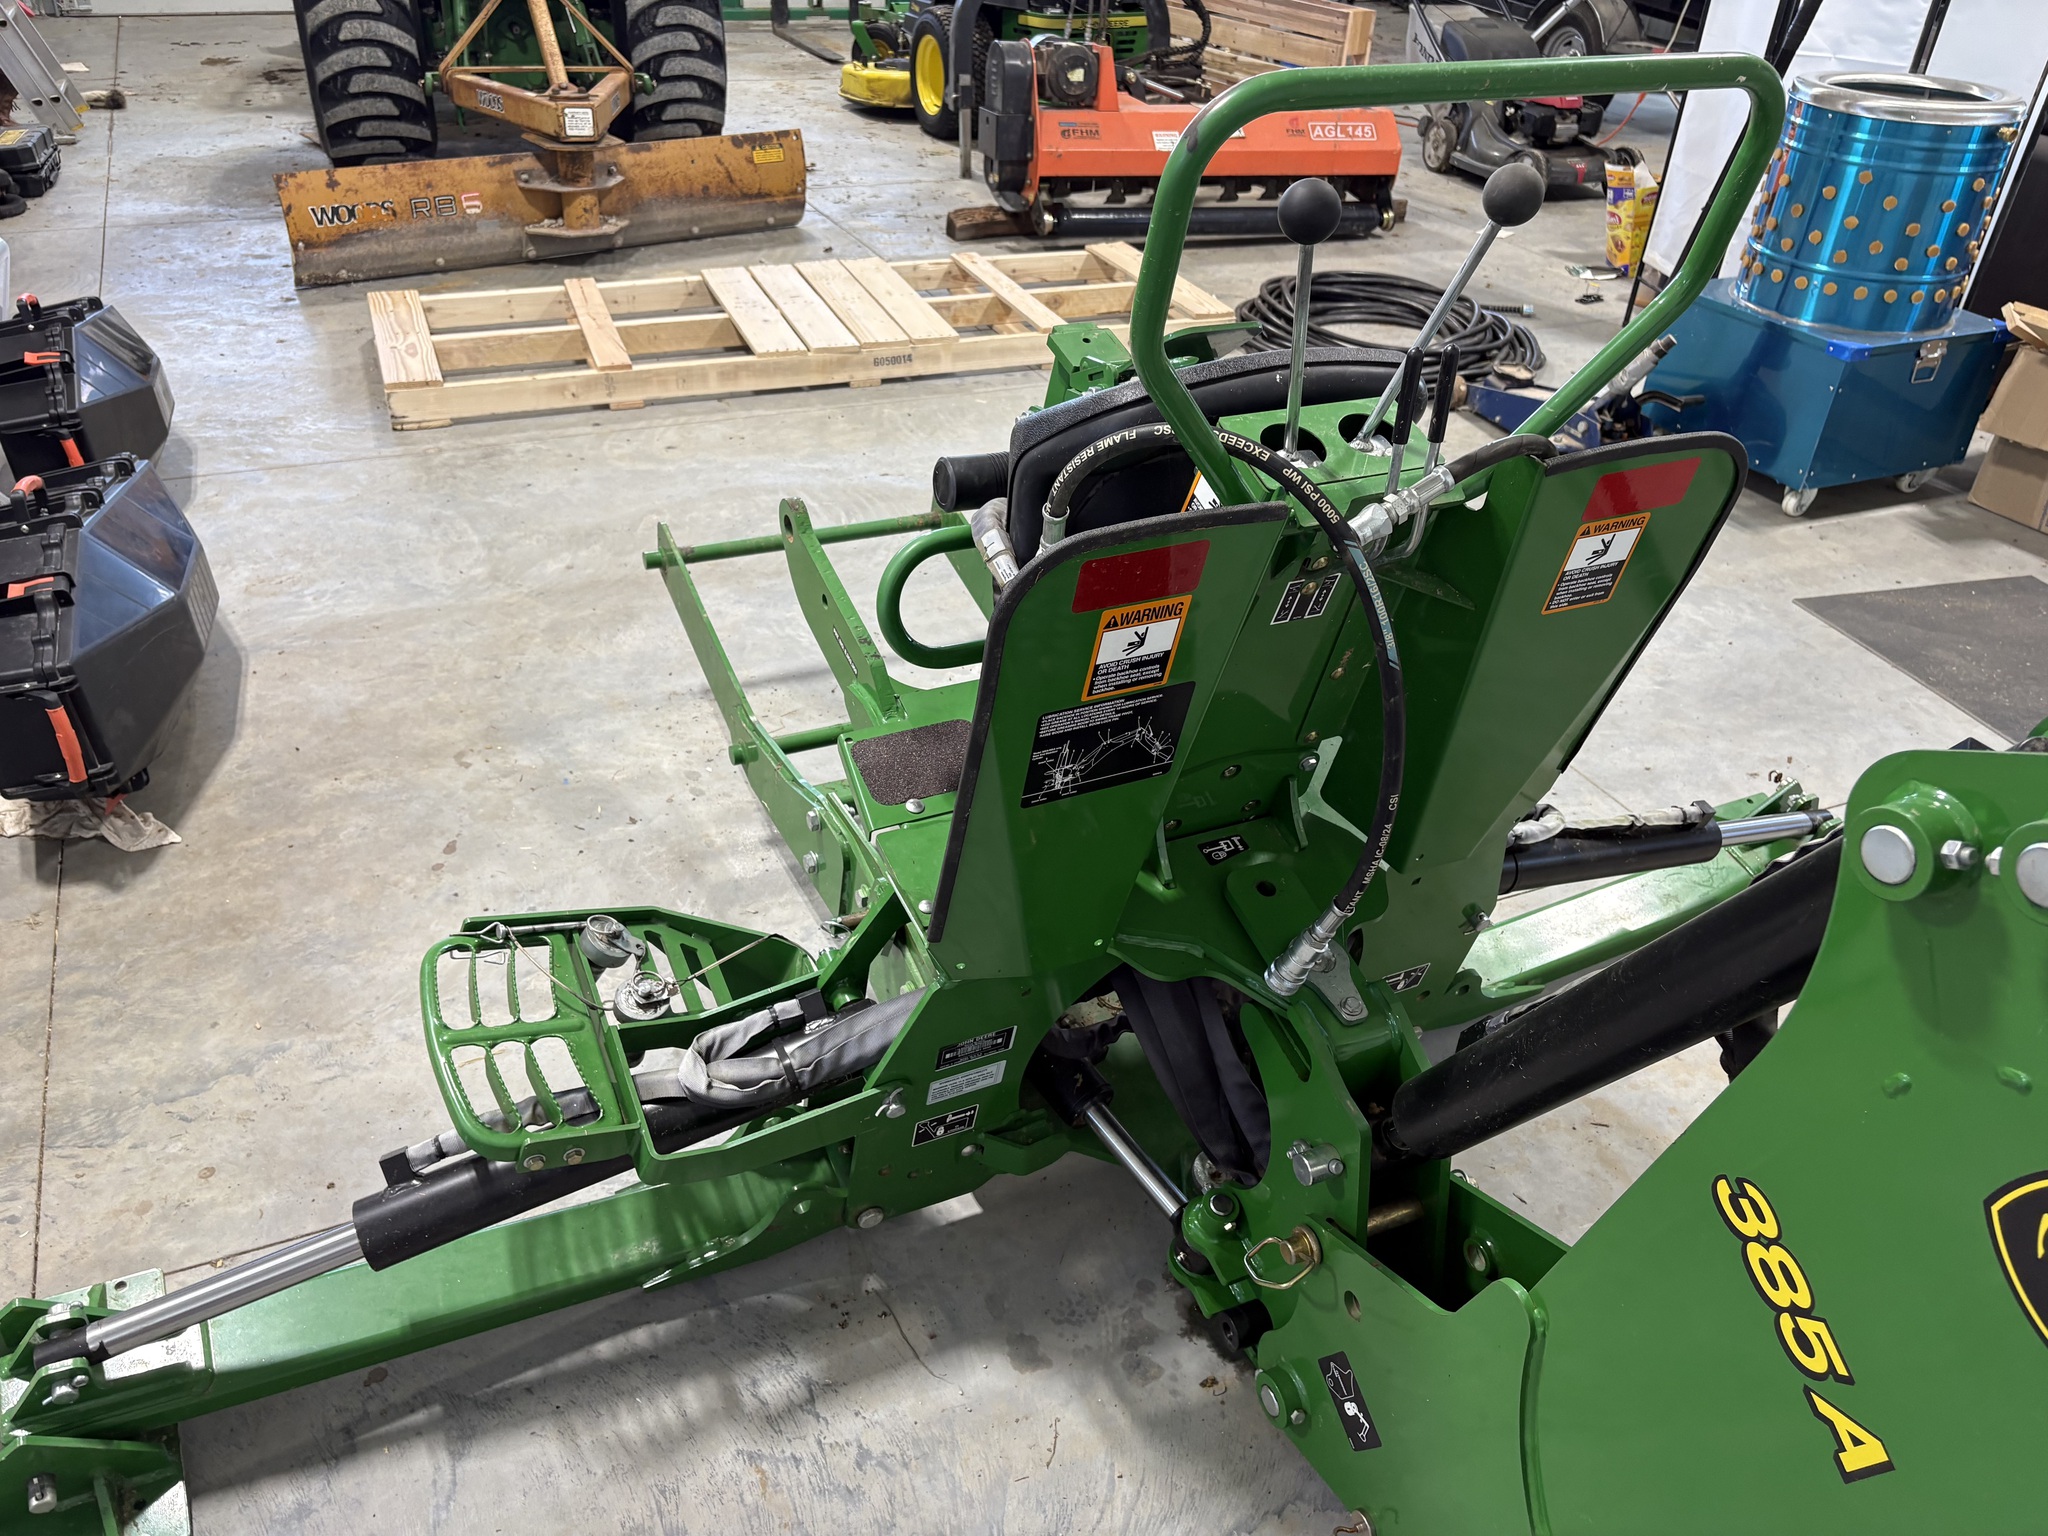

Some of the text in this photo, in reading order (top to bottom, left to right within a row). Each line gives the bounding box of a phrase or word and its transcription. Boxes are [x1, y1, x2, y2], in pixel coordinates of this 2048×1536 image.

[308, 200, 397, 227] WOS
[1153, 424, 1175, 435] SC
[1097, 428, 1137, 452] FLAME
[1052, 449, 1095, 497] RESISTANT
[1282, 467, 1302, 485] WP
[1300, 481, 1320, 501] PSI
[1317, 498, 1340, 525] 5000
[1593, 516, 1646, 534] WARNING
[1120, 601, 1185, 627] WARNING
[1098, 652, 1164, 669] AVOID CRUSH INJURY
[1108, 664, 1129, 673] DEATH
[1388, 793, 1399, 811] CSI
[1362, 858, 1380, 885] MSHA
